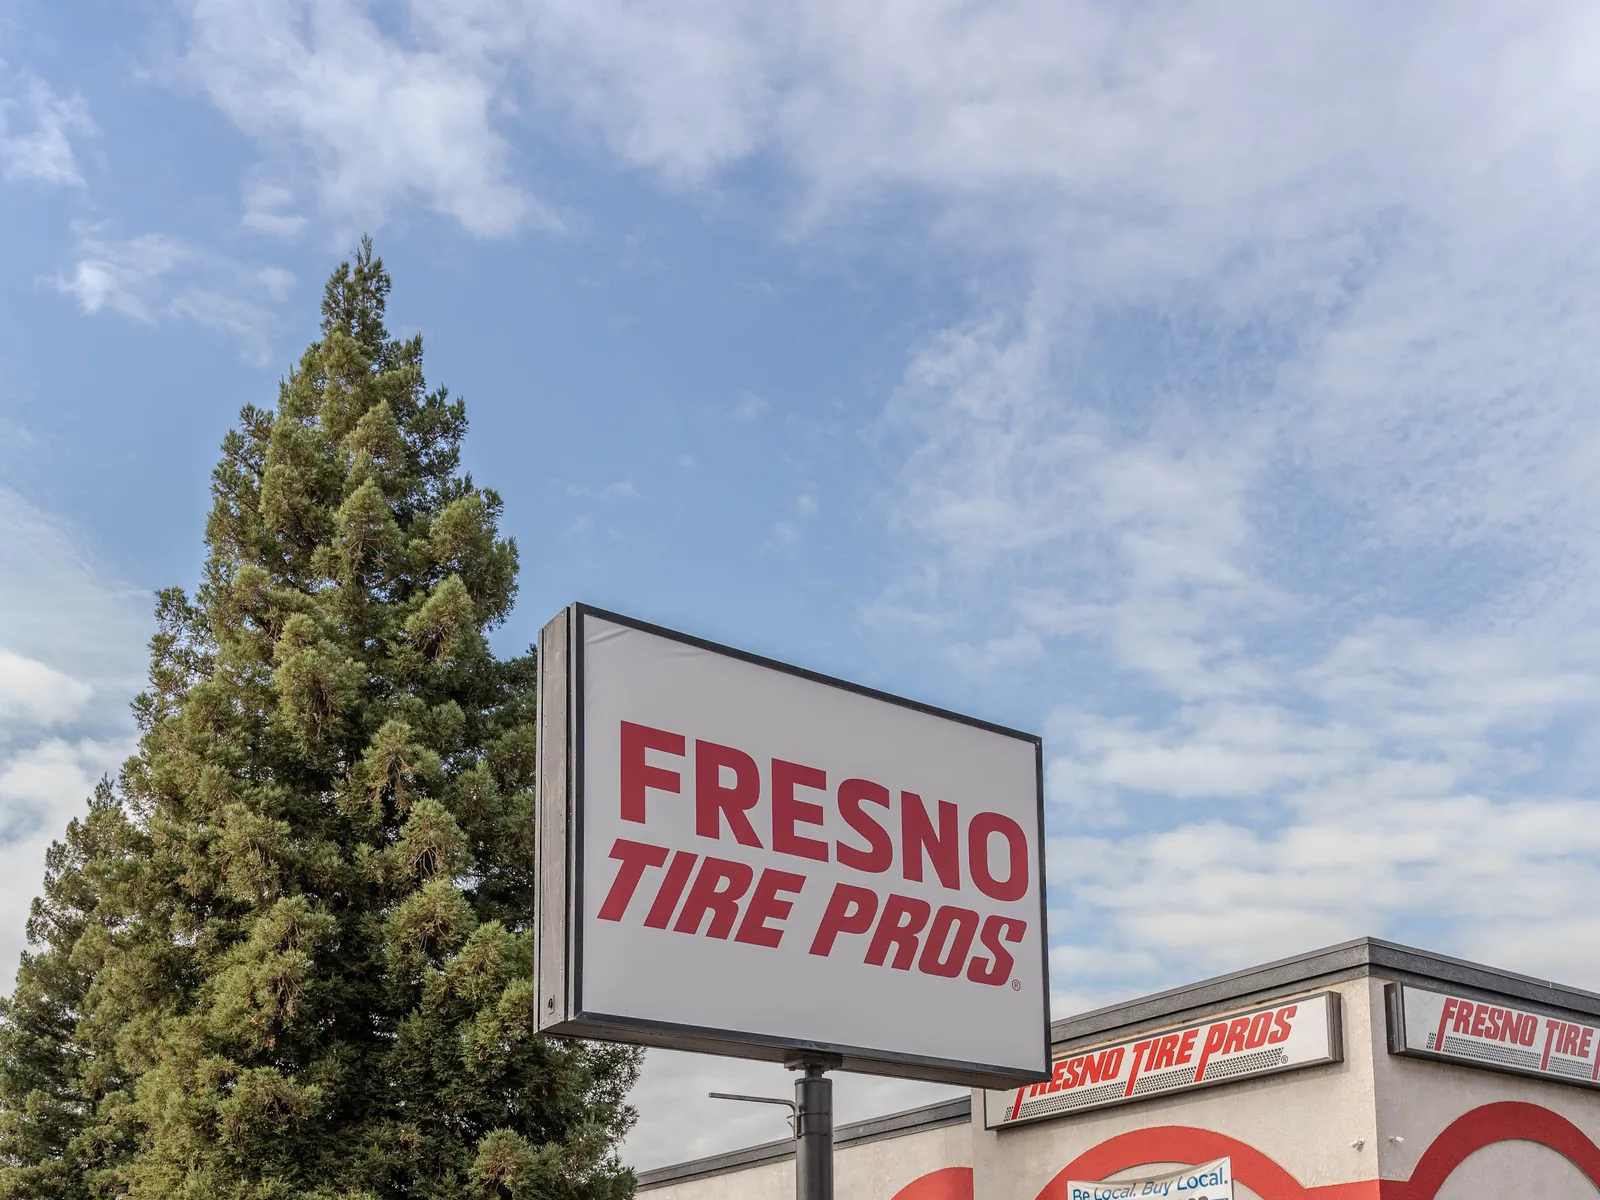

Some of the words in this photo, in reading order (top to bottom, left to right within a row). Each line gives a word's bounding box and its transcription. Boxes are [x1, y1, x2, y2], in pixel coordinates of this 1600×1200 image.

[620, 720, 1029, 902] FRESNO
[597, 838, 807, 948] TIRE
[808, 882, 1027, 986] PROS
[1124, 1028, 1199, 1096] TIRE
[1194, 1005, 1298, 1082] PROS
[1434, 997, 1538, 1051] FRESNO
[1540, 1019, 1594, 1071] TIRE
[1141, 1180, 1174, 1197] Buy
[1177, 1167, 1229, 1191] Local.
